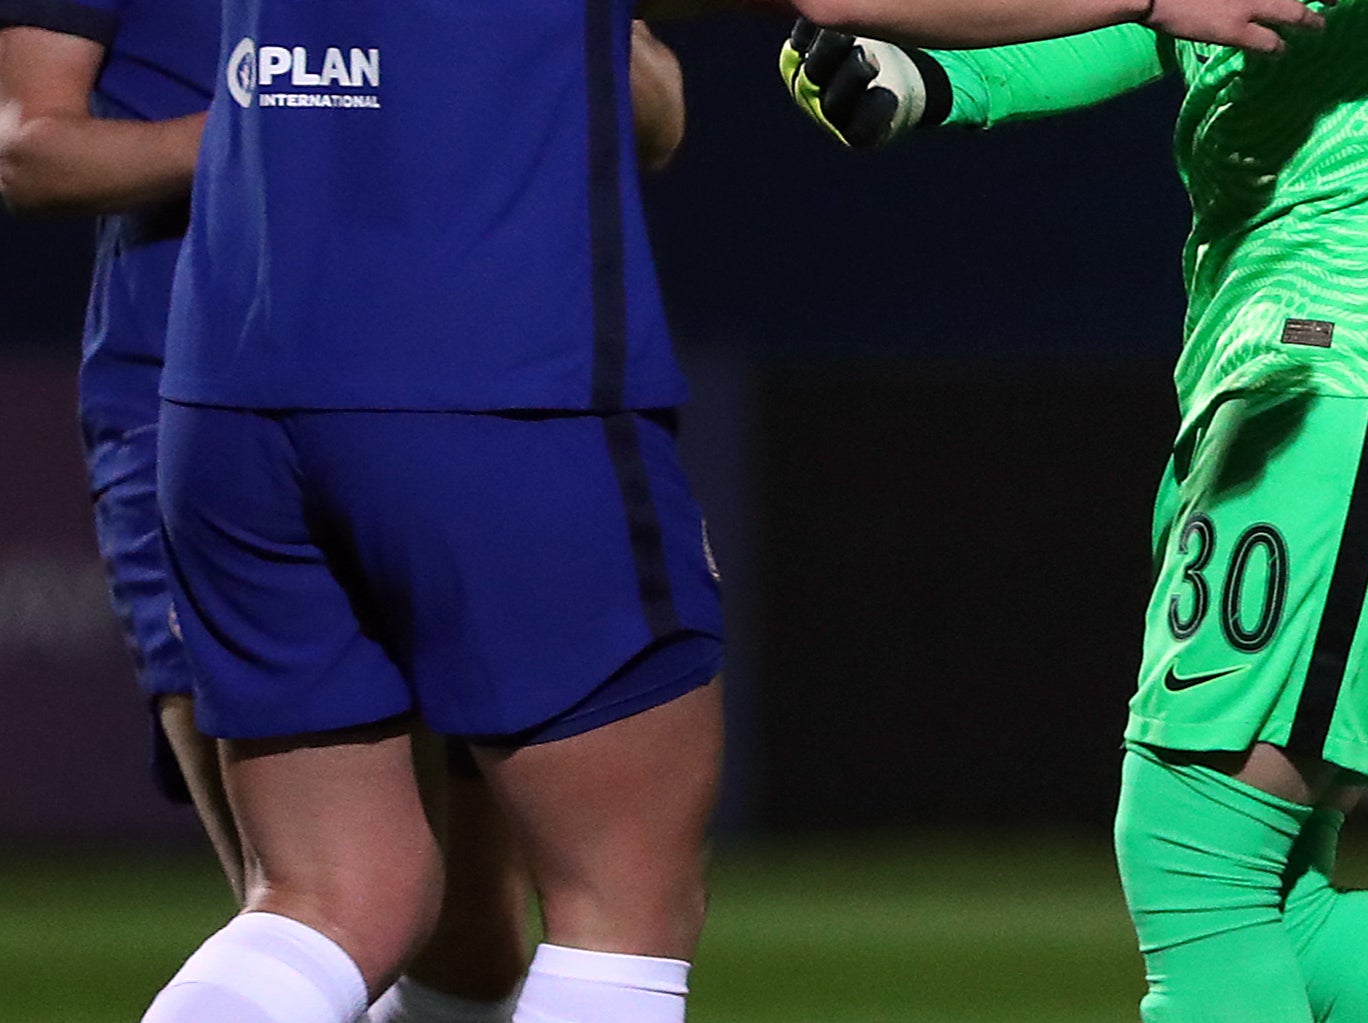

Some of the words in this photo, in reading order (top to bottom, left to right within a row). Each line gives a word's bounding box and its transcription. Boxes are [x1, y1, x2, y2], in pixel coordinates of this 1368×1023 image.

[259, 46, 380, 87] PLAN
[259, 93, 381, 108] INTERNATIONAL
[1168, 511, 1289, 654] 30
